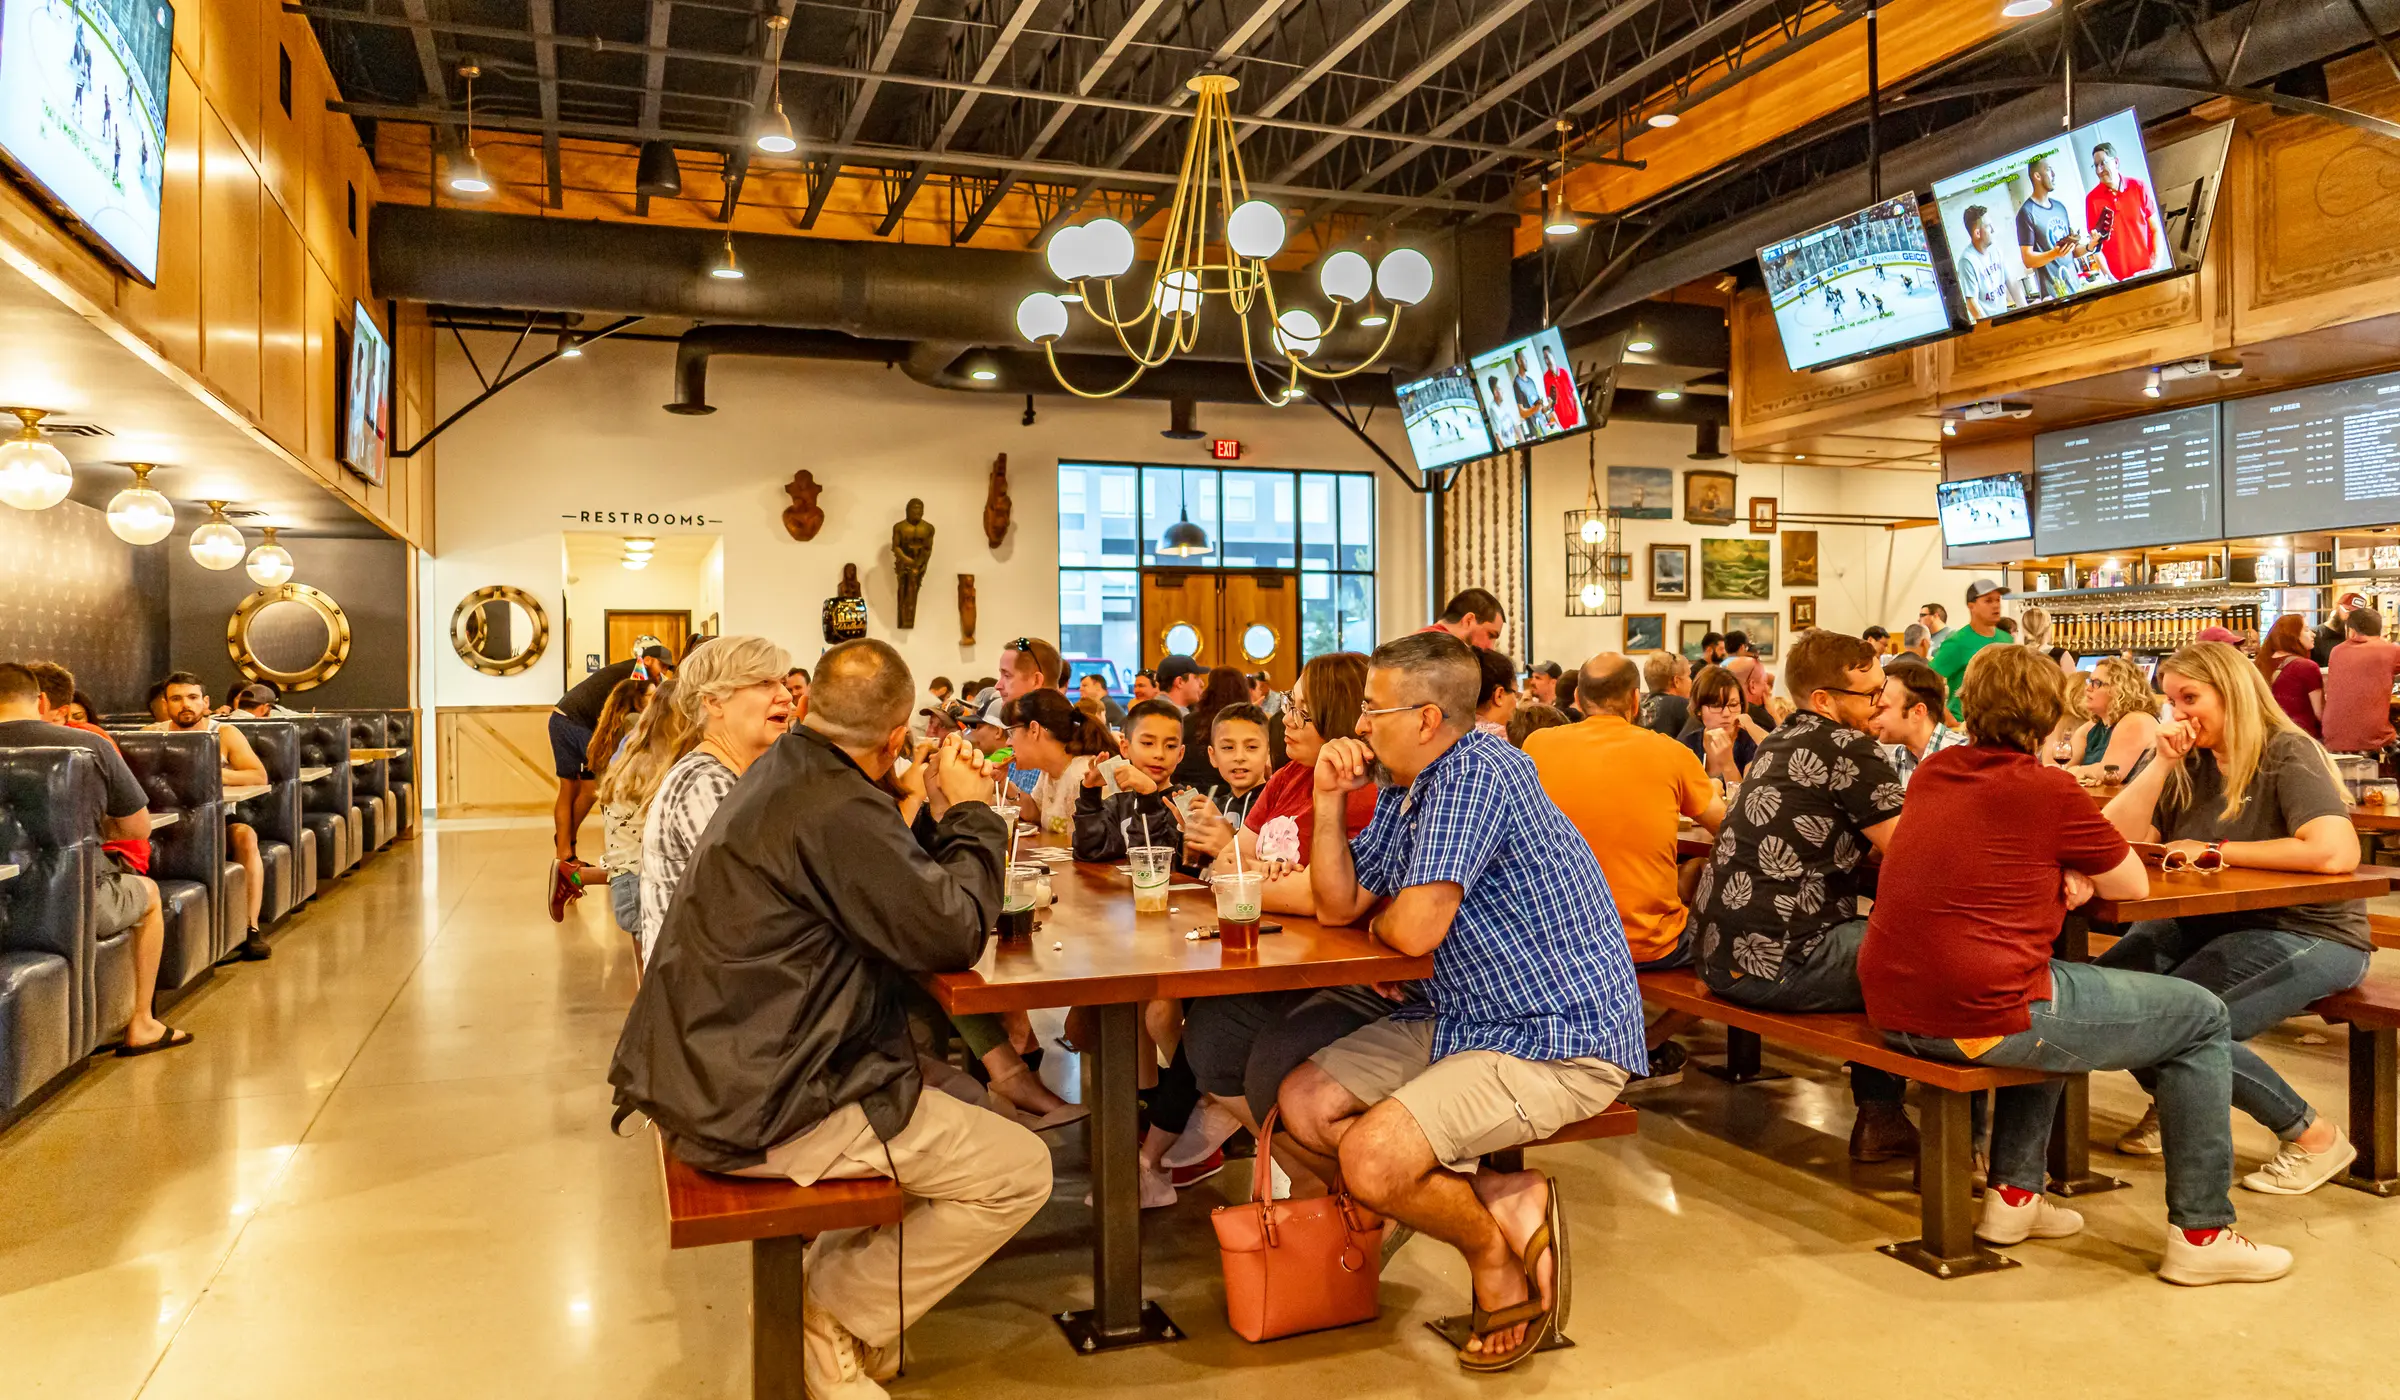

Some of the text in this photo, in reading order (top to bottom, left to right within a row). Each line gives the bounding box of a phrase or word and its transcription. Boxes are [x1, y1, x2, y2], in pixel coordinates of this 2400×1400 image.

[1902, 252, 1928, 262] GEICO
[1217, 441, 1237, 457] EXIT
[580, 511, 705, 526] RESTROOMS
